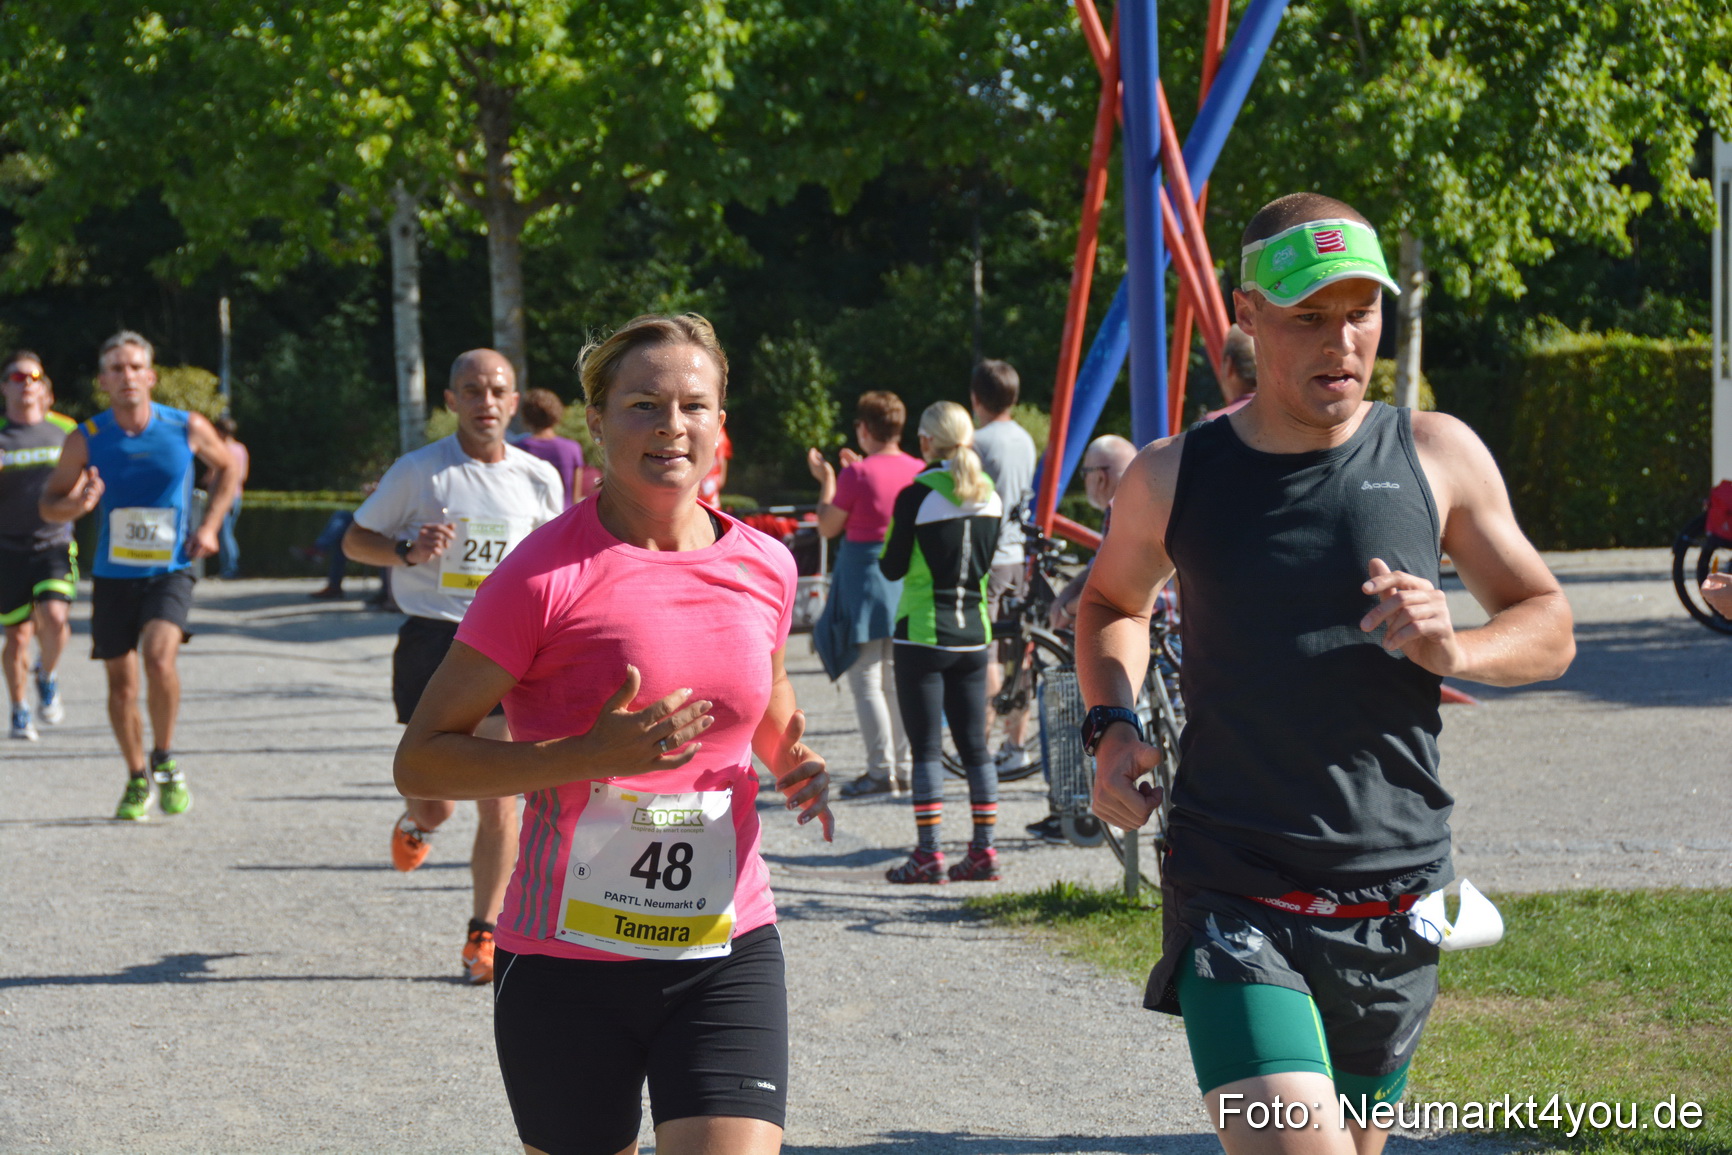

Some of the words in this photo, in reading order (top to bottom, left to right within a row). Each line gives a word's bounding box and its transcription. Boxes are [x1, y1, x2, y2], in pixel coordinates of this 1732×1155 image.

[125, 522, 158, 541] 307
[463, 539, 507, 563] 247
[632, 808, 704, 826] BOCK
[578, 867, 585, 876] B
[630, 841, 694, 891] 48
[604, 891, 641, 906] PARTL
[644, 898, 693, 909] Neumarkt
[614, 914, 690, 942] Tamara
